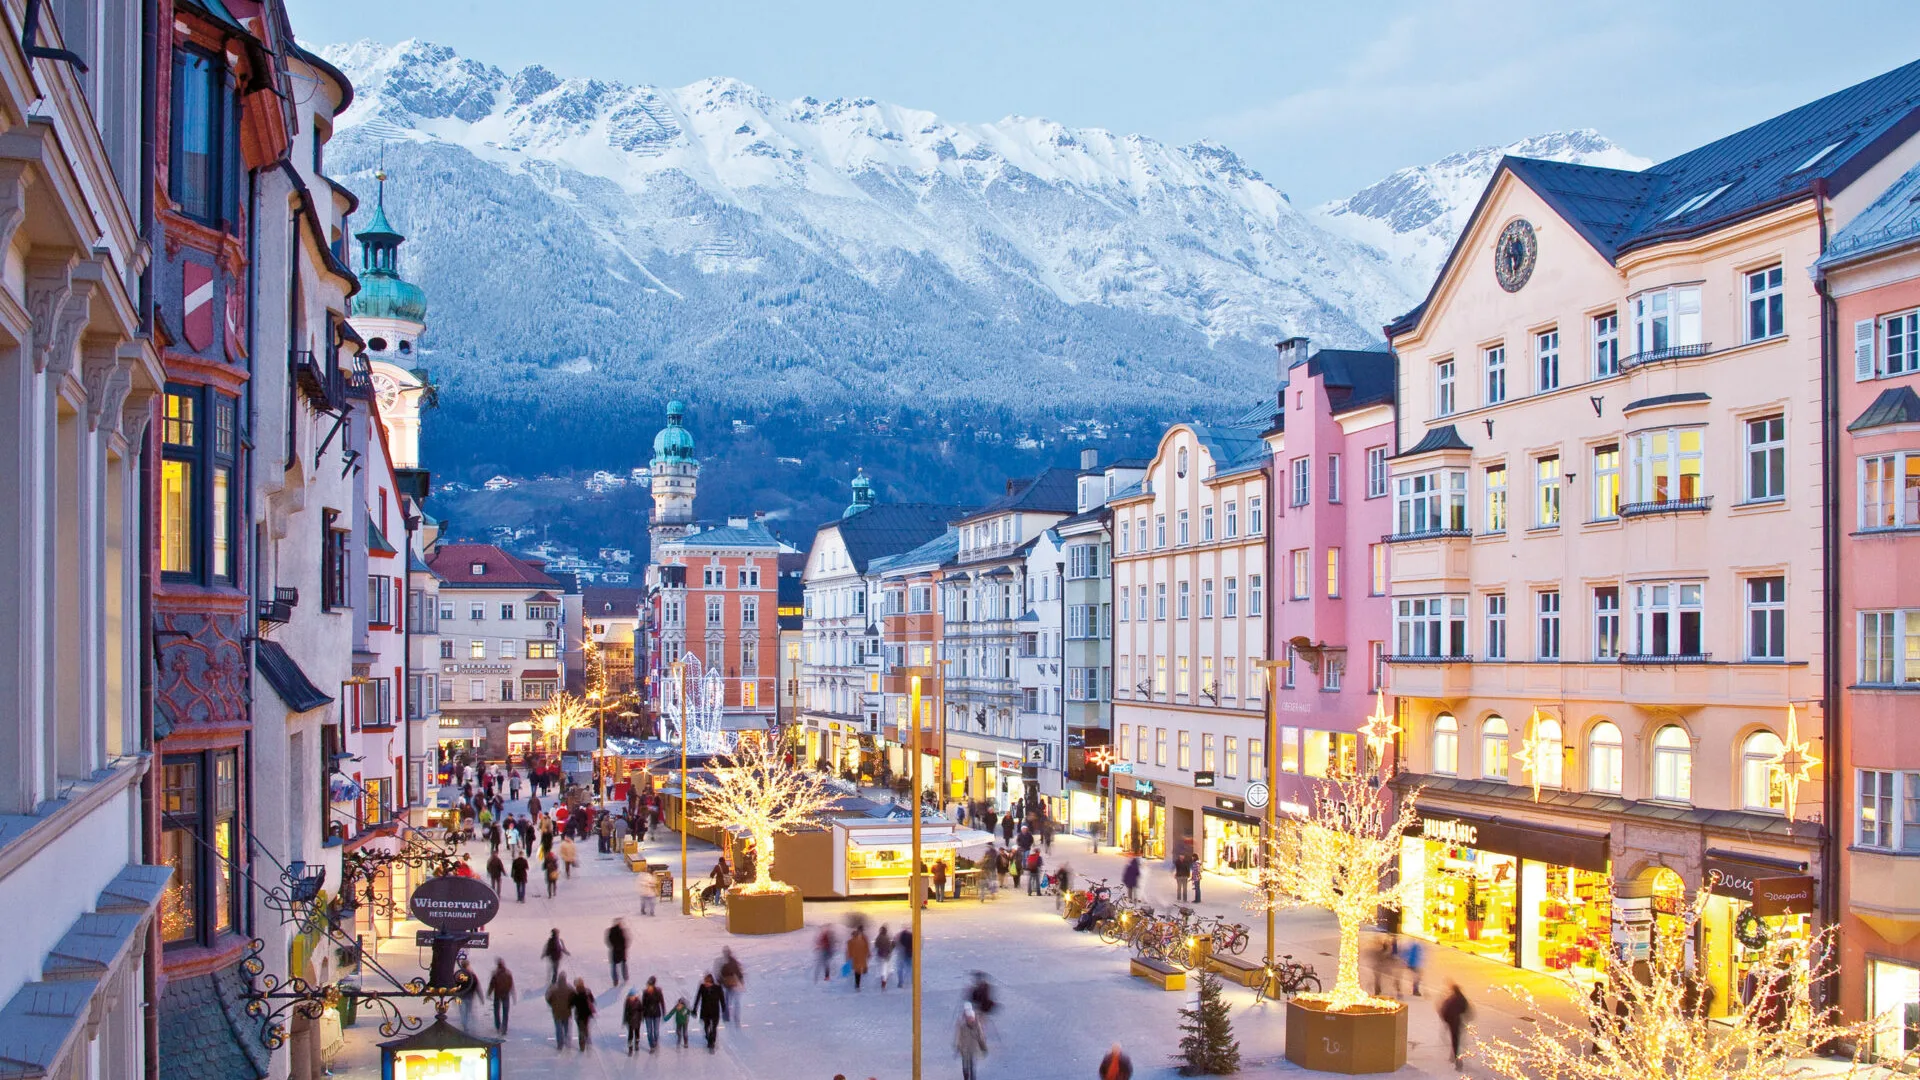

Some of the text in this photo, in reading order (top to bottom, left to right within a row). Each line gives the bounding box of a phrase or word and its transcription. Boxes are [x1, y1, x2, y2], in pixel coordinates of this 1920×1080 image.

[438, 718, 459, 726] ILLA
[1423, 818, 1478, 845] HUMANIC
[1708, 868, 1754, 896] Weig
[1763, 890, 1808, 902] Weigand
